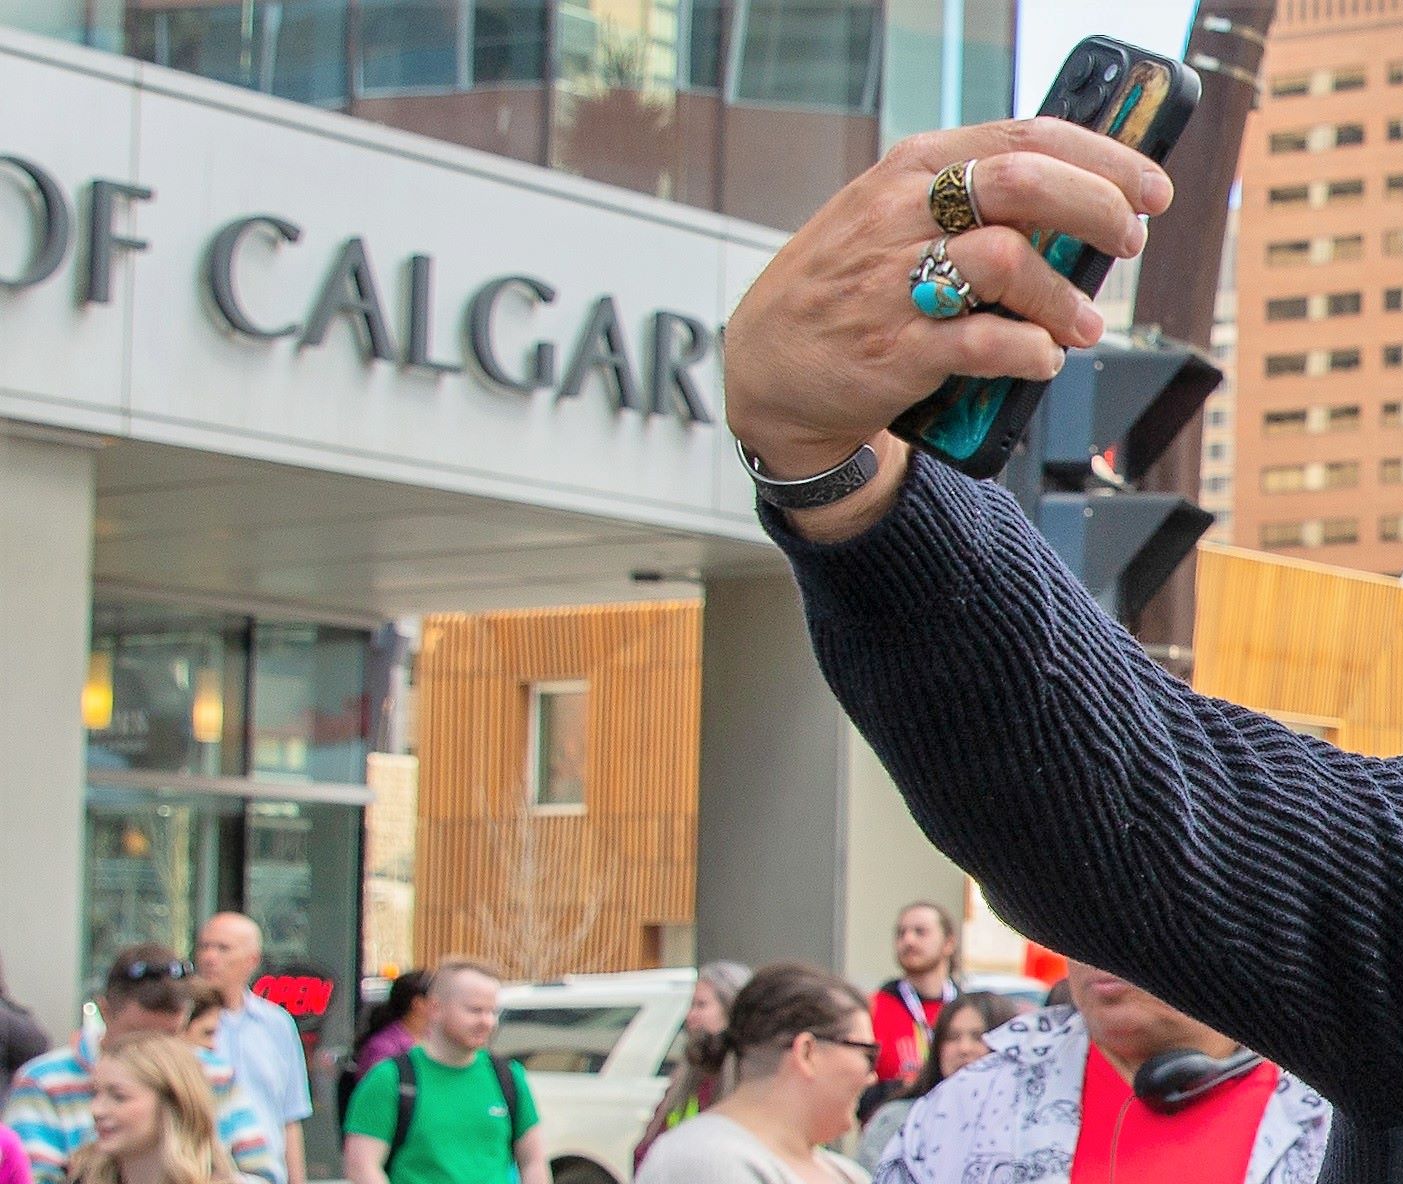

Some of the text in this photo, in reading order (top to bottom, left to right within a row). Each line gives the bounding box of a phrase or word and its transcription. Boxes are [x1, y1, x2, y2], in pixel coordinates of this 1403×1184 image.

[0, 155, 724, 424] OF CALGAR
[251, 974, 334, 1016] OPEN
